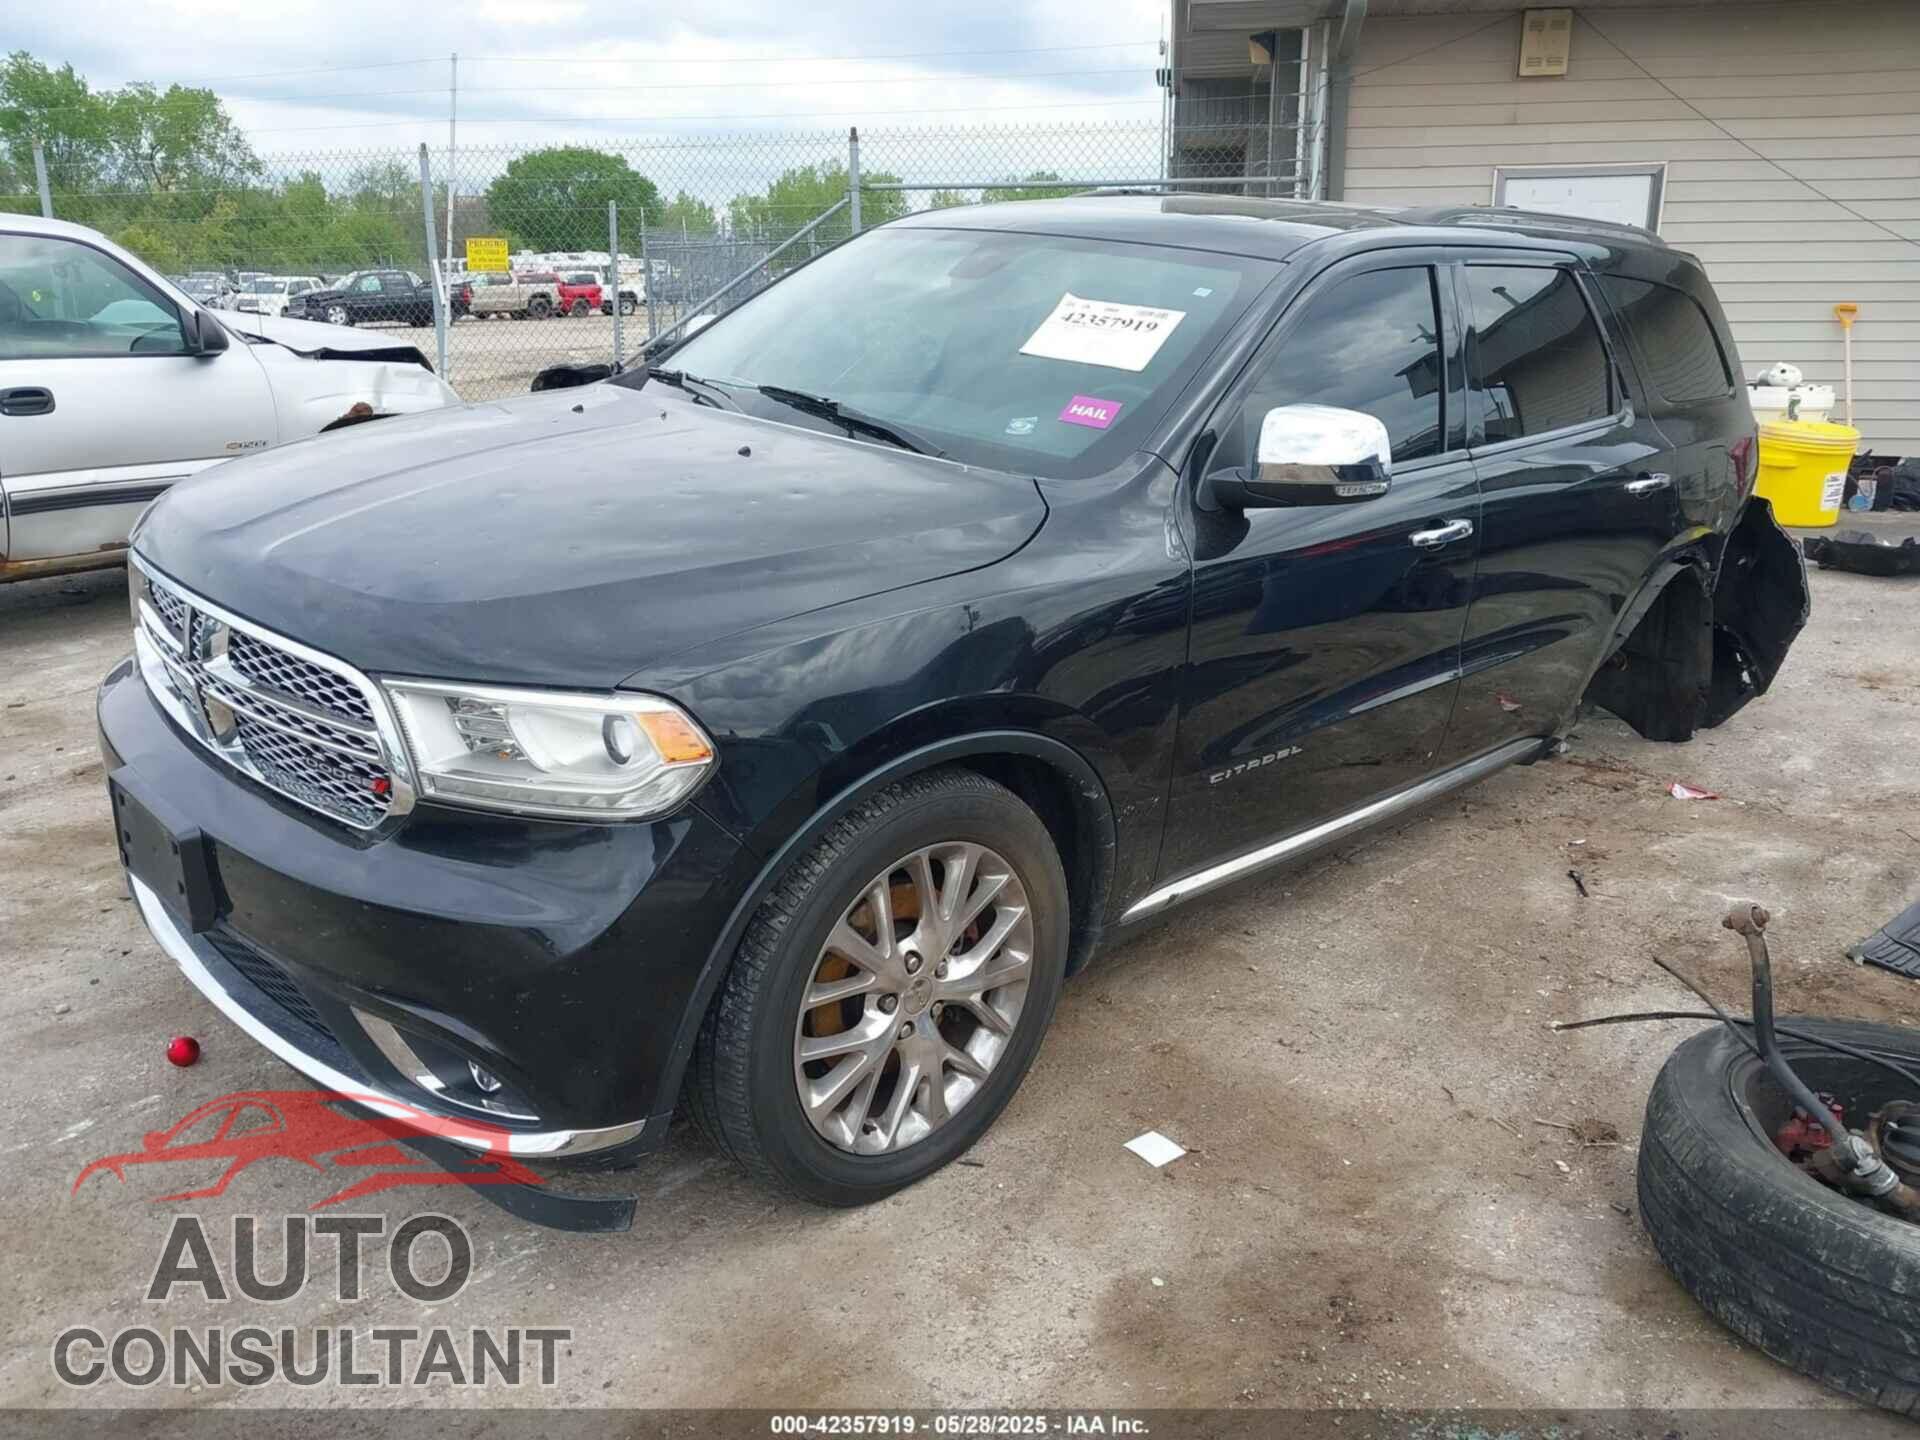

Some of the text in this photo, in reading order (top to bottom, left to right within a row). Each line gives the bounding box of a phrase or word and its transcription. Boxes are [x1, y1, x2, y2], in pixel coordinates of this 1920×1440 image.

[1061, 312, 1158, 332] 42357919
[1069, 404, 1107, 420] HAIL
[1209, 745, 1303, 784] CITADEL
